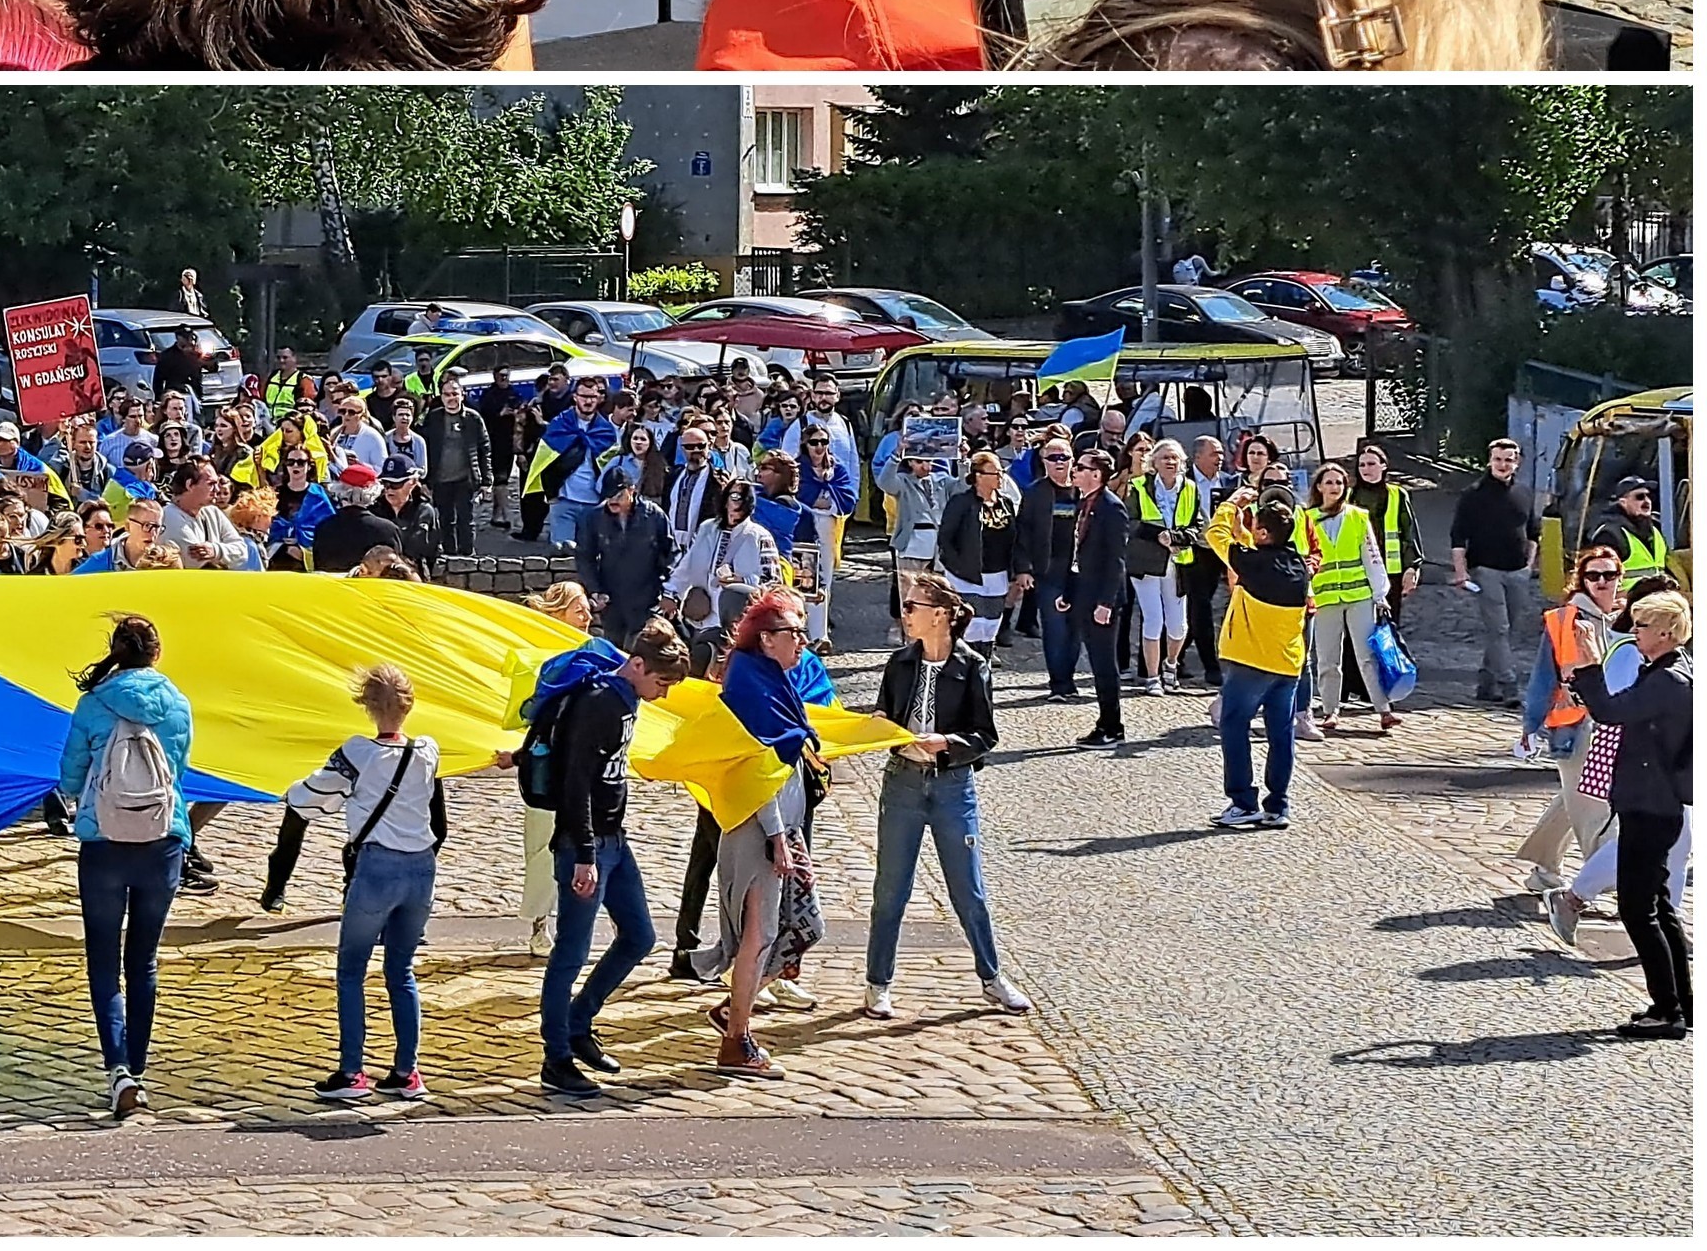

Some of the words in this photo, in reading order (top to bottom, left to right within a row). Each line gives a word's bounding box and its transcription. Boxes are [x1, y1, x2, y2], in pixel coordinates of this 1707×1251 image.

[12, 322, 67, 345] KONSULAT
[14, 342, 57, 361] ROSYJSKI
[19, 374, 31, 389] W
[35, 364, 85, 386] GDAŃSKU
